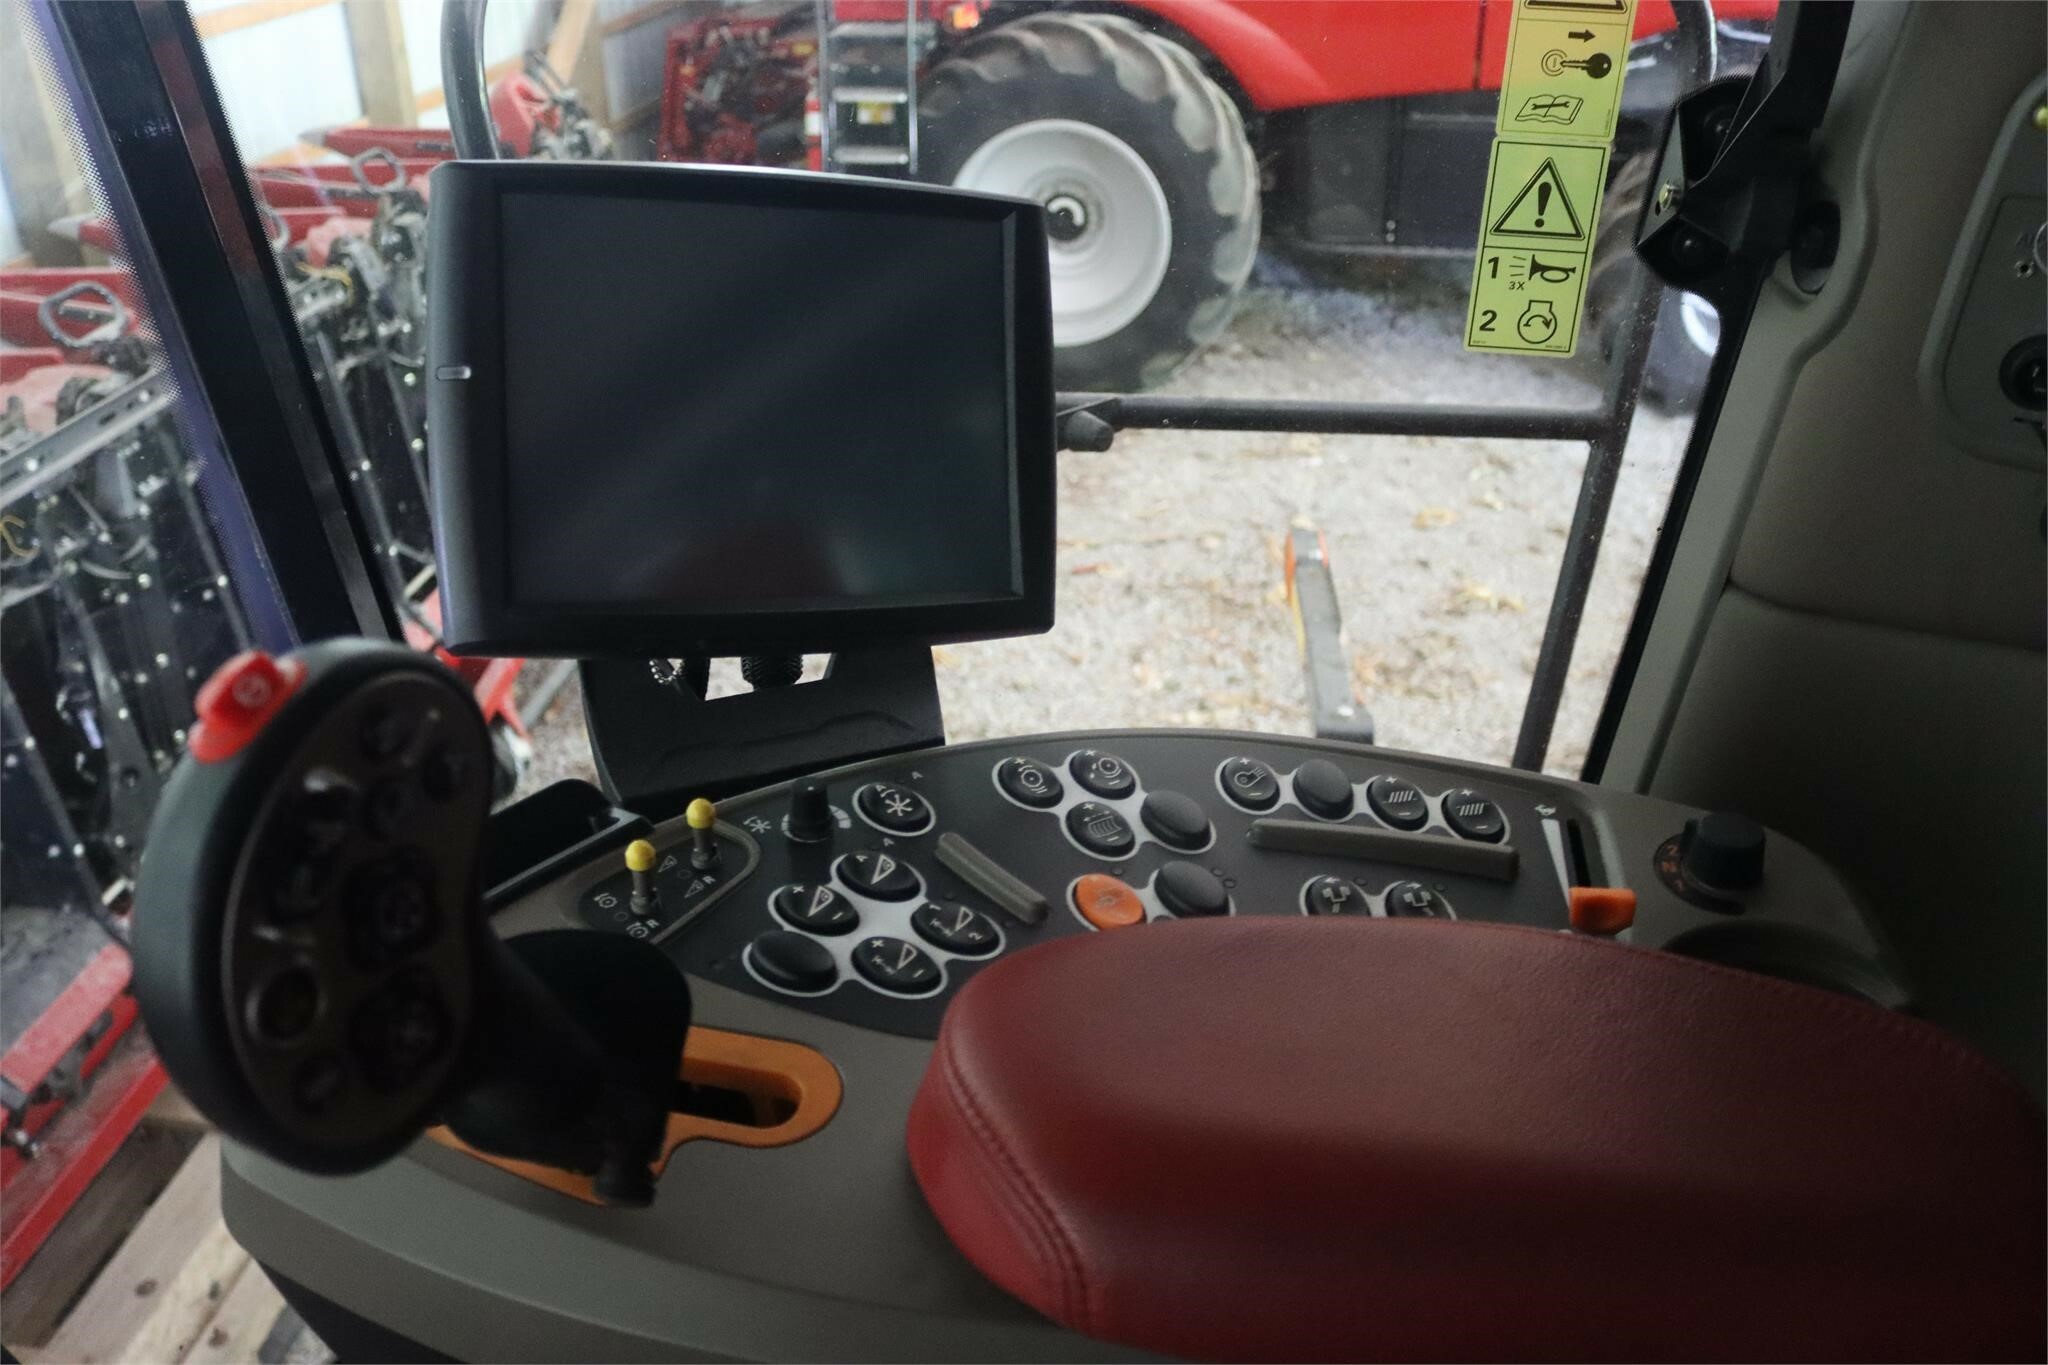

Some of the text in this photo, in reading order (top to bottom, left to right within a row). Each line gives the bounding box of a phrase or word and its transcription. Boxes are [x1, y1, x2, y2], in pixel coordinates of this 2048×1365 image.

[1488, 256, 1499, 279] 1
[1509, 281, 1525, 291] 3X
[1479, 310, 1497, 332] 2
[911, 771, 924, 780] A
